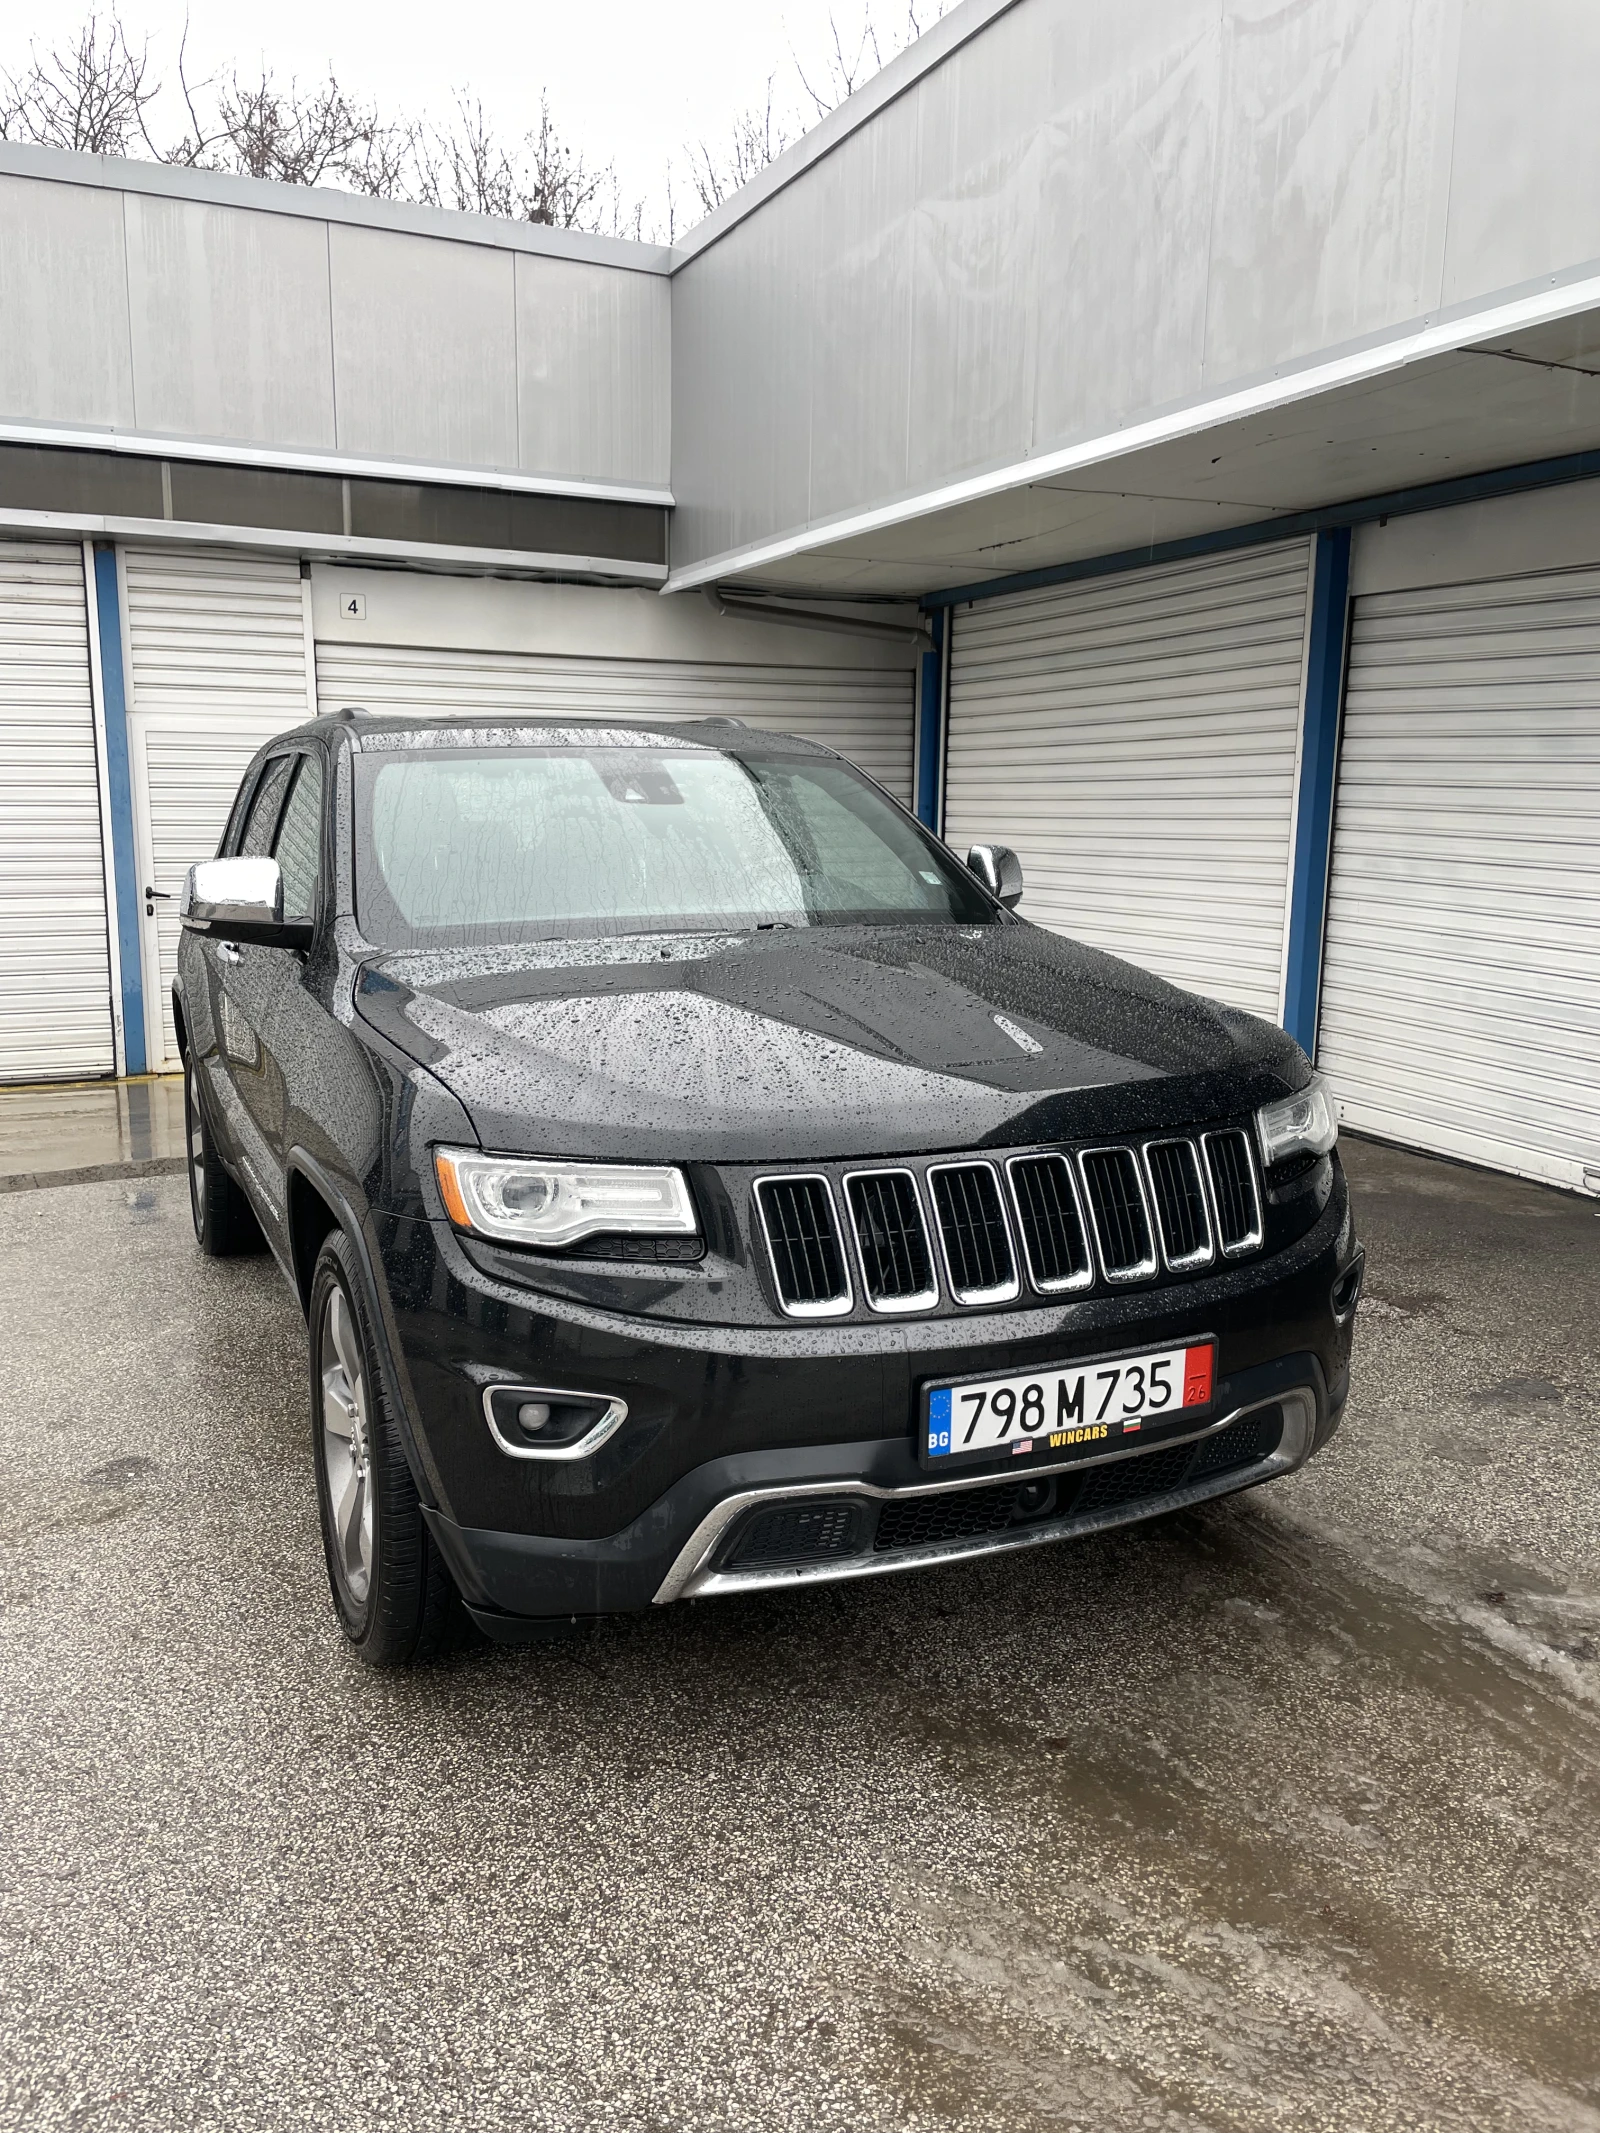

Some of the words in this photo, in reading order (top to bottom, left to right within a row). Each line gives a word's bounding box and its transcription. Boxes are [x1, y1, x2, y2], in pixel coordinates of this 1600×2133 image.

[347, 599, 359, 614] 4
[960, 1383, 1045, 1444] 798
[1056, 1375, 1085, 1428] M
[1095, 1359, 1171, 1420] 735
[1187, 1384, 1206, 1402] 26
[928, 1431, 949, 1449] BG
[1049, 1424, 1108, 1448] WINCARS
